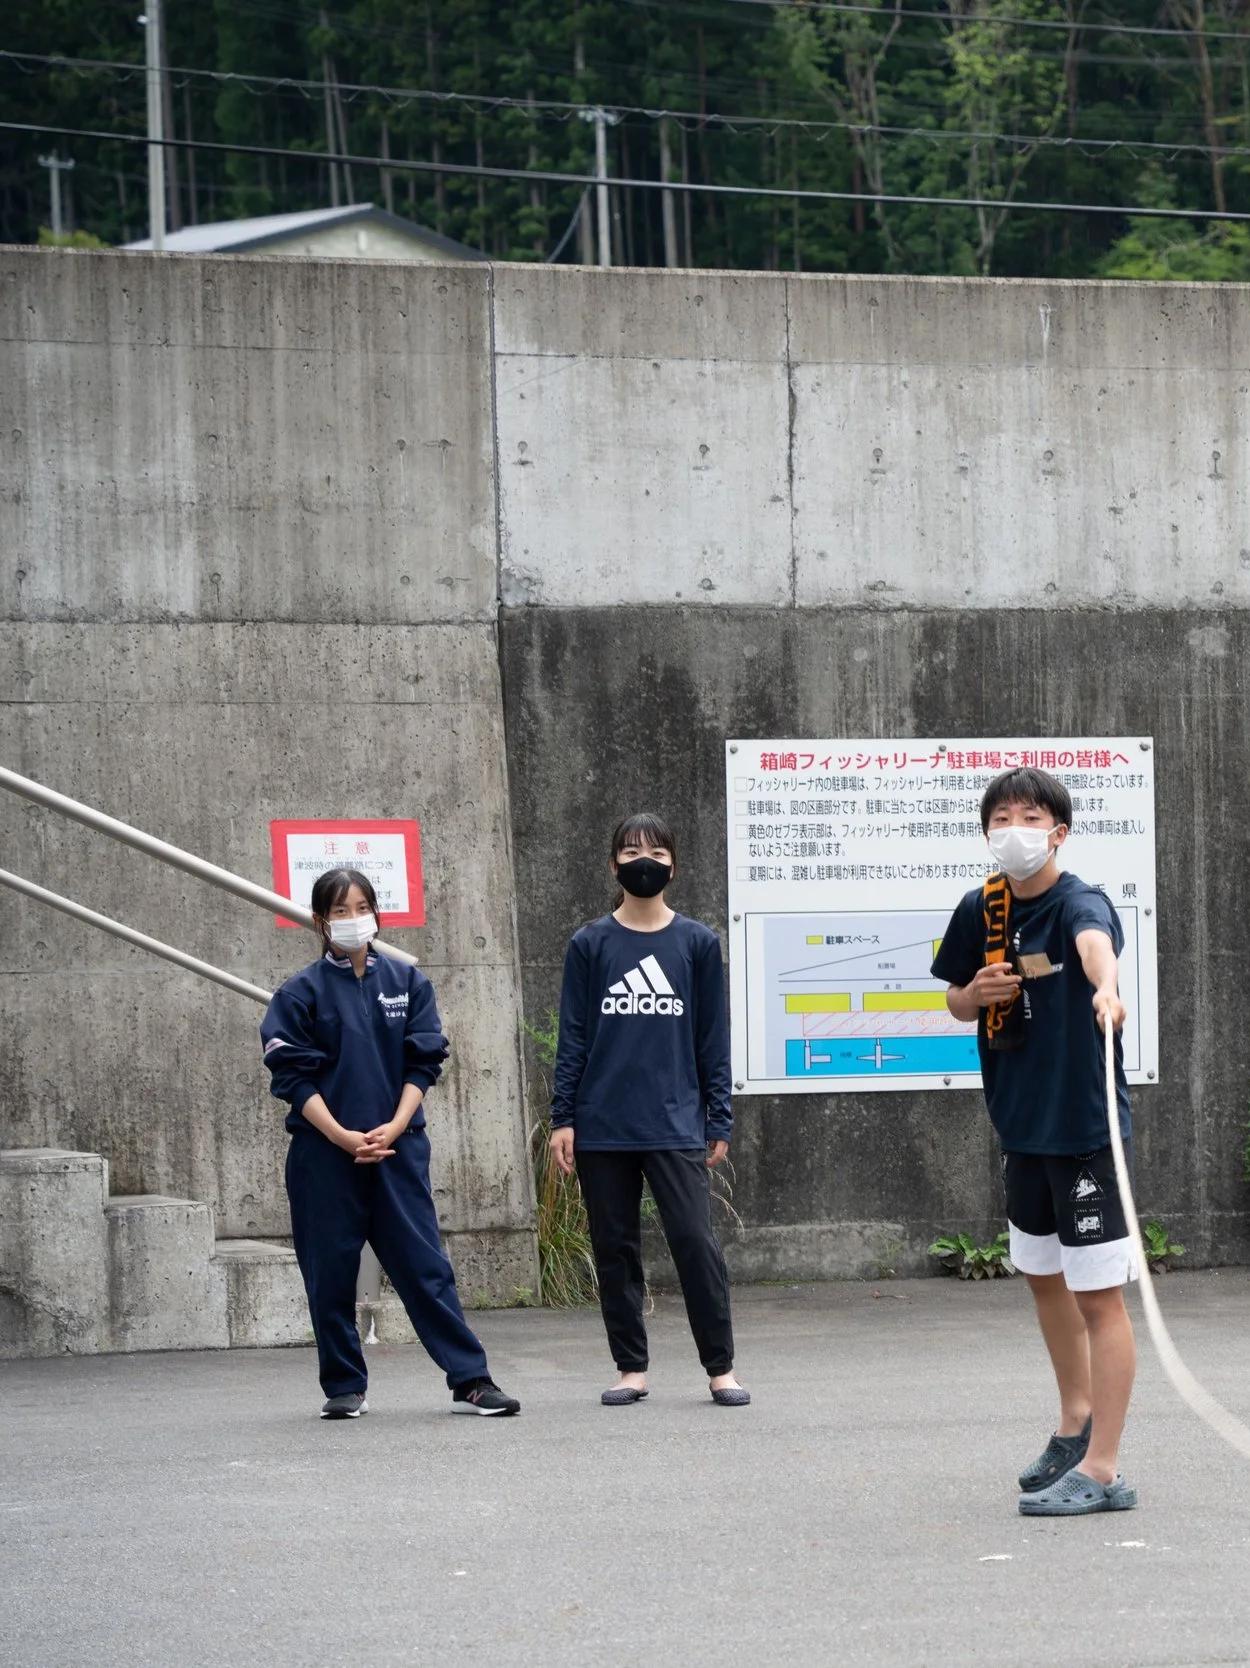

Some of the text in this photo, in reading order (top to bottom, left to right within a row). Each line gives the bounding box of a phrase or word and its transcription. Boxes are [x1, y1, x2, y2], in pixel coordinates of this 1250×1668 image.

[760, 750, 1129, 771] 箱崎フィッシャリーナ駐車場ご利用の皆様へ
[325, 841, 370, 855] 注意
[749, 841, 846, 857] ないようご注意願います。
[826, 934, 880, 945] 駐車スペース
[601, 992, 684, 1016] adidas
